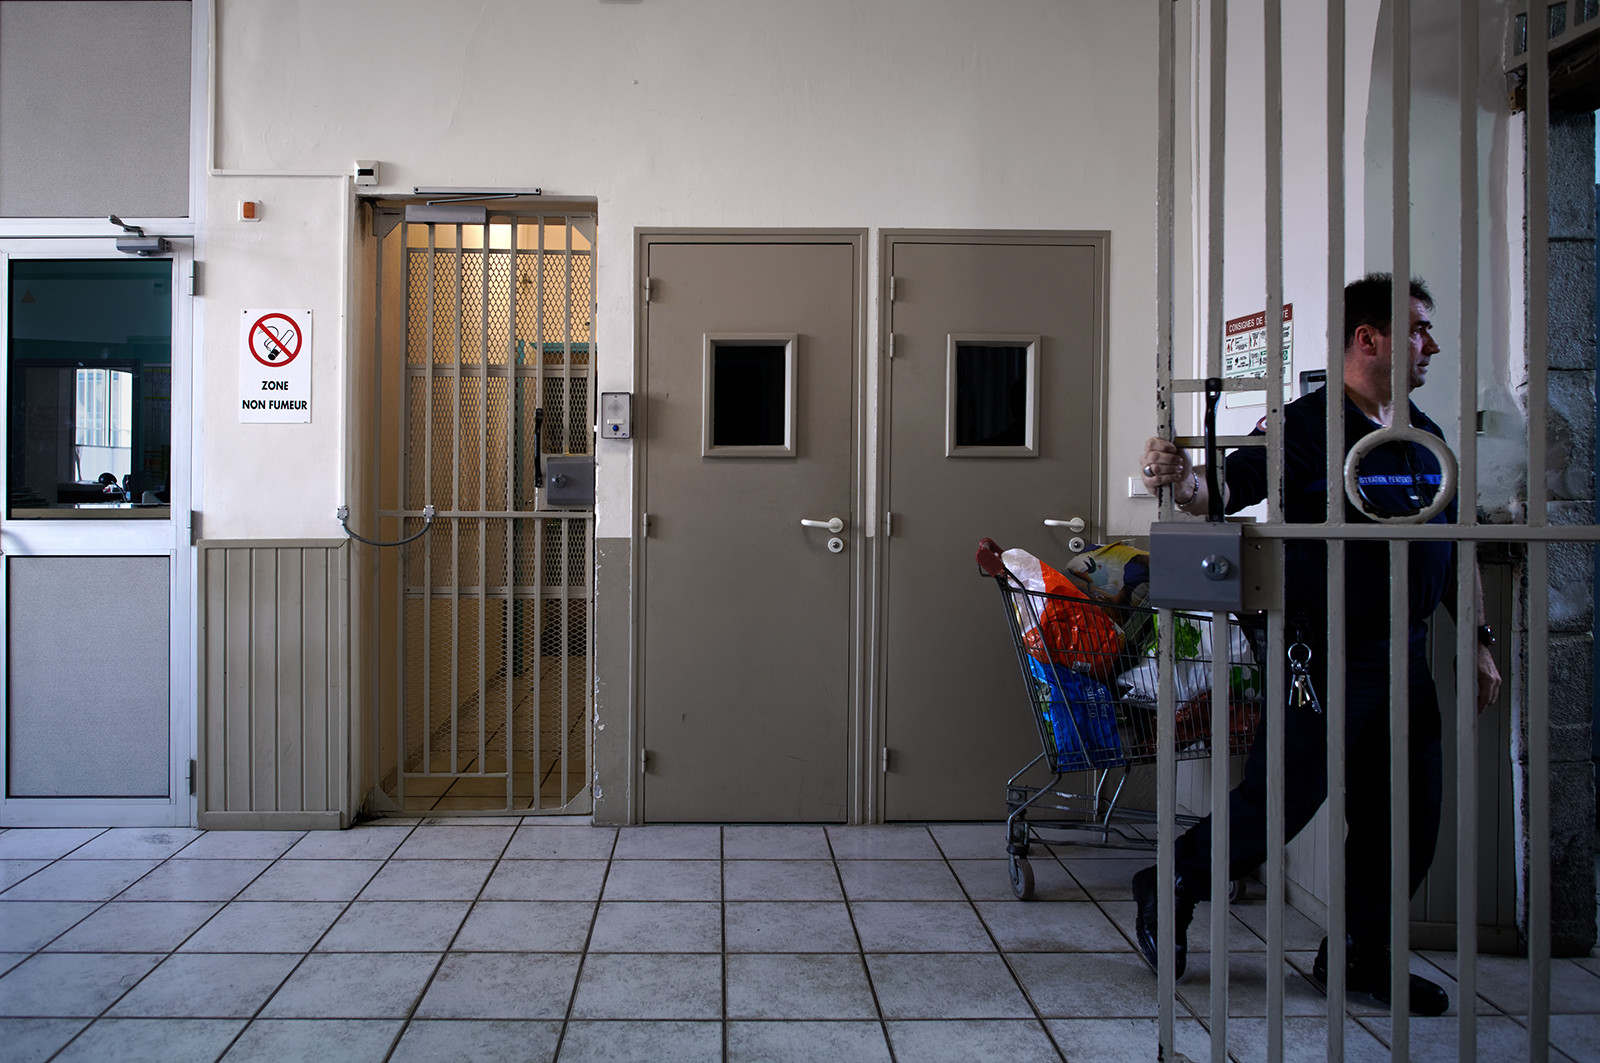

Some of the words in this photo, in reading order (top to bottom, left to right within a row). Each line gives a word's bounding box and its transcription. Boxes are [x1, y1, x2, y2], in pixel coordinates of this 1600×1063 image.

[1228, 318, 1255, 332] CONSIGNES
[1255, 316, 1263, 326] DE
[261, 380, 289, 391] ZONE
[242, 399, 266, 410] NON
[268, 400, 308, 410] FUMEUR
